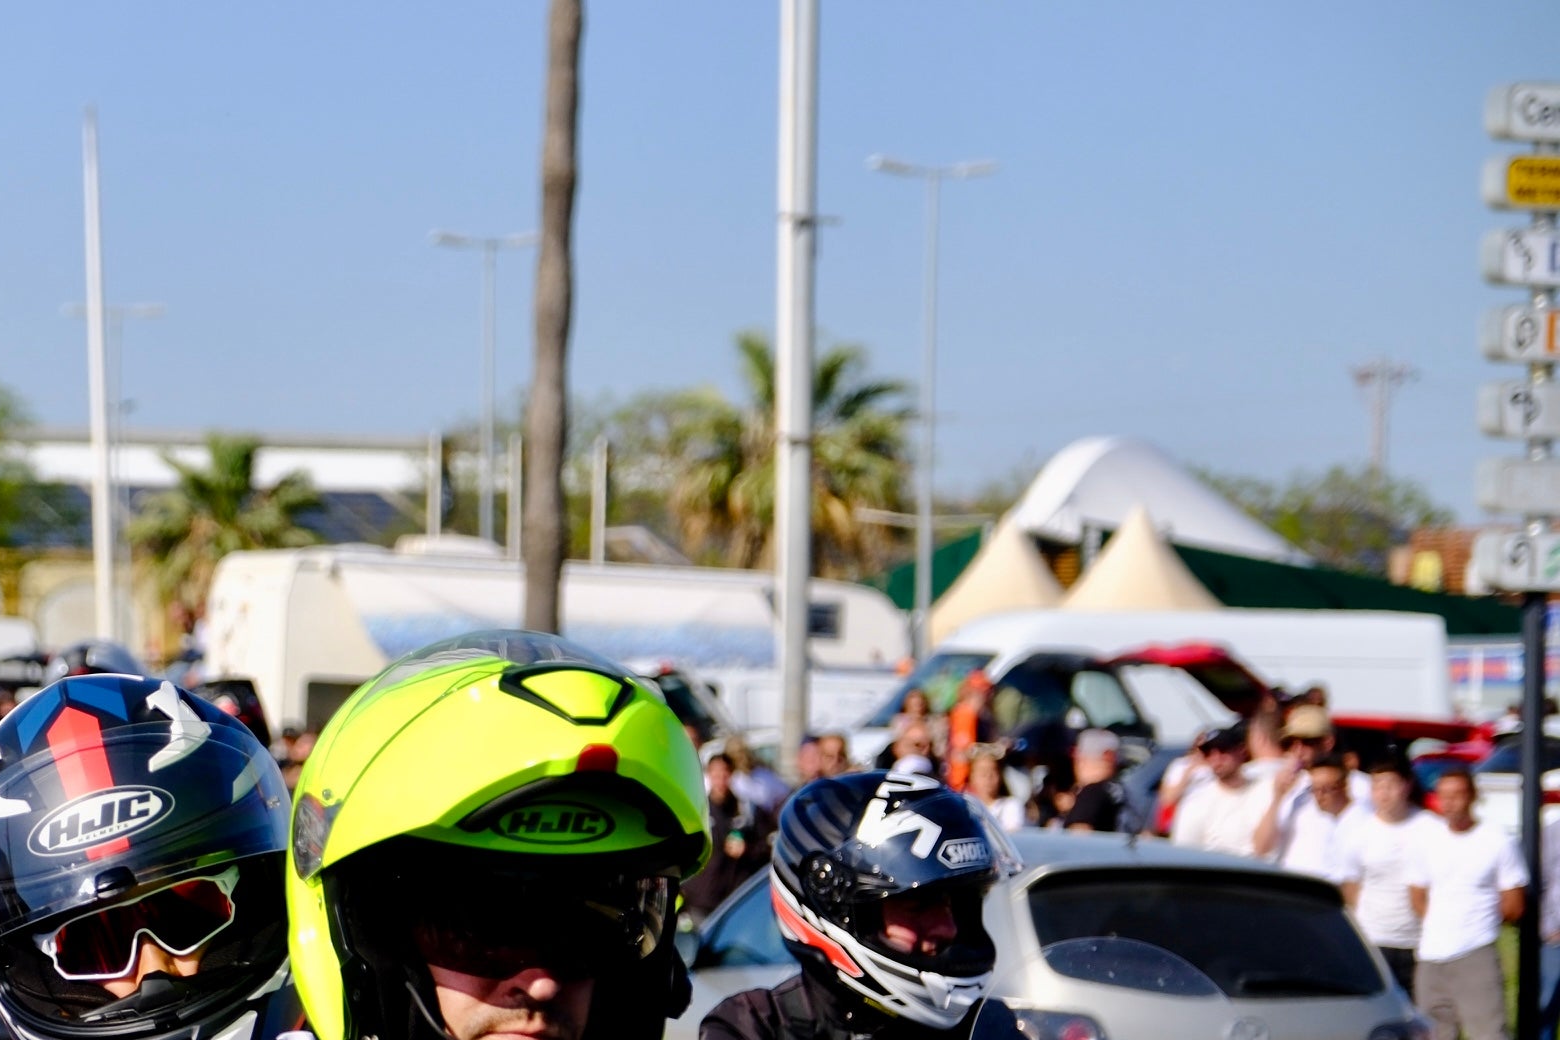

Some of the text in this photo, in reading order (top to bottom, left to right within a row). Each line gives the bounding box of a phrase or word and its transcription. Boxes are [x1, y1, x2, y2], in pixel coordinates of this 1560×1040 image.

[48, 793, 151, 849] HJC
[78, 823, 129, 842] HELMETS
[506, 811, 601, 834] HJC
